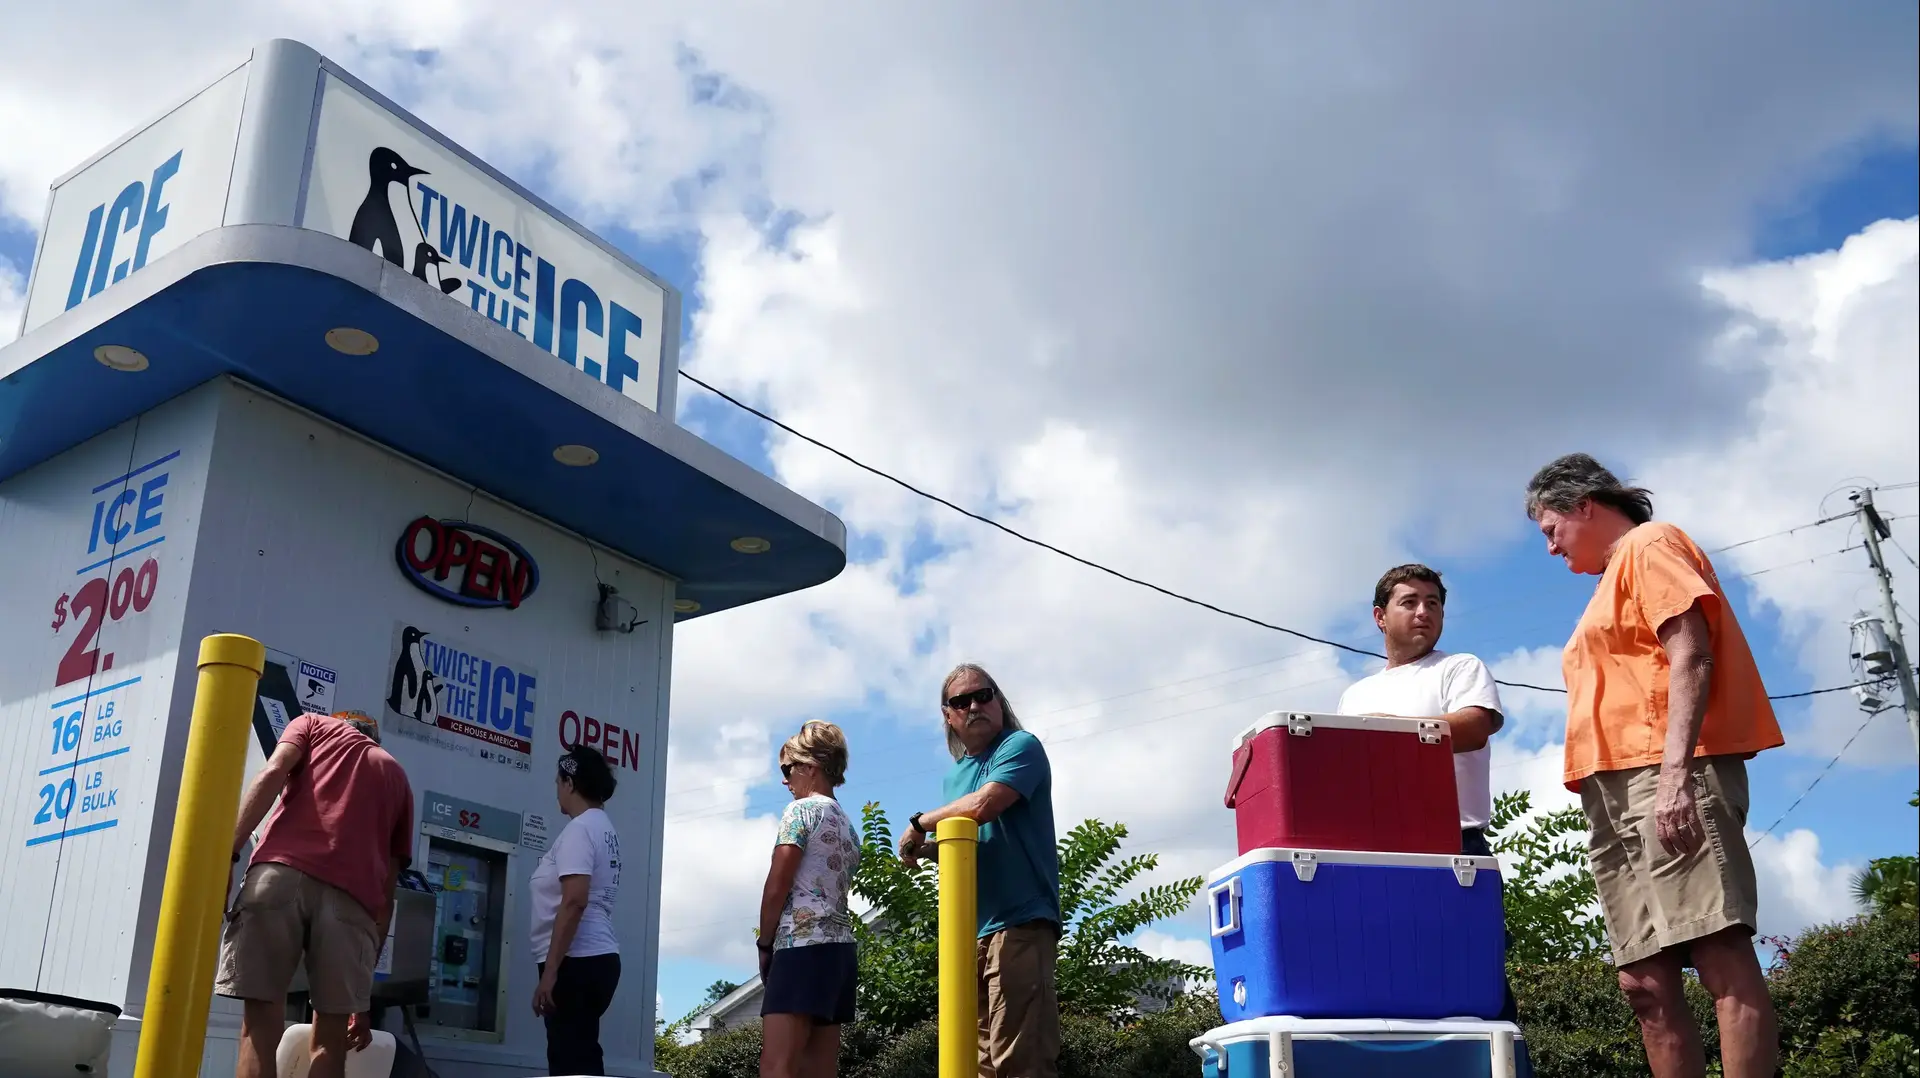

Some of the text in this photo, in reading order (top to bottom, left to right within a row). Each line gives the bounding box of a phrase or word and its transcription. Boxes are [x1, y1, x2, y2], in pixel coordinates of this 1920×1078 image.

[65, 149, 183, 312] ICE
[417, 182, 532, 302] TWICE
[467, 279, 529, 338] THE
[533, 256, 642, 393] ICE
[87, 472, 169, 554] ICE
[406, 517, 528, 609] OPEN
[302, 664, 334, 682] NOTICE
[423, 639, 479, 687] TWICE
[97, 701, 114, 720] LB
[268, 701, 284, 724] BULK
[446, 683, 476, 721] THE
[477, 659, 536, 738] ICE
[52, 710, 83, 755] 16
[93, 720, 122, 742] BAG
[451, 722, 463, 732] ICE
[464, 725, 487, 740] HOUSE
[488, 733, 519, 749] AMERICA
[559, 710, 639, 772] OPEN
[33, 778, 77, 825] 20
[81, 788, 118, 813] BULK
[85, 771, 103, 790] LB
[432, 801, 481, 829] ICE $2
